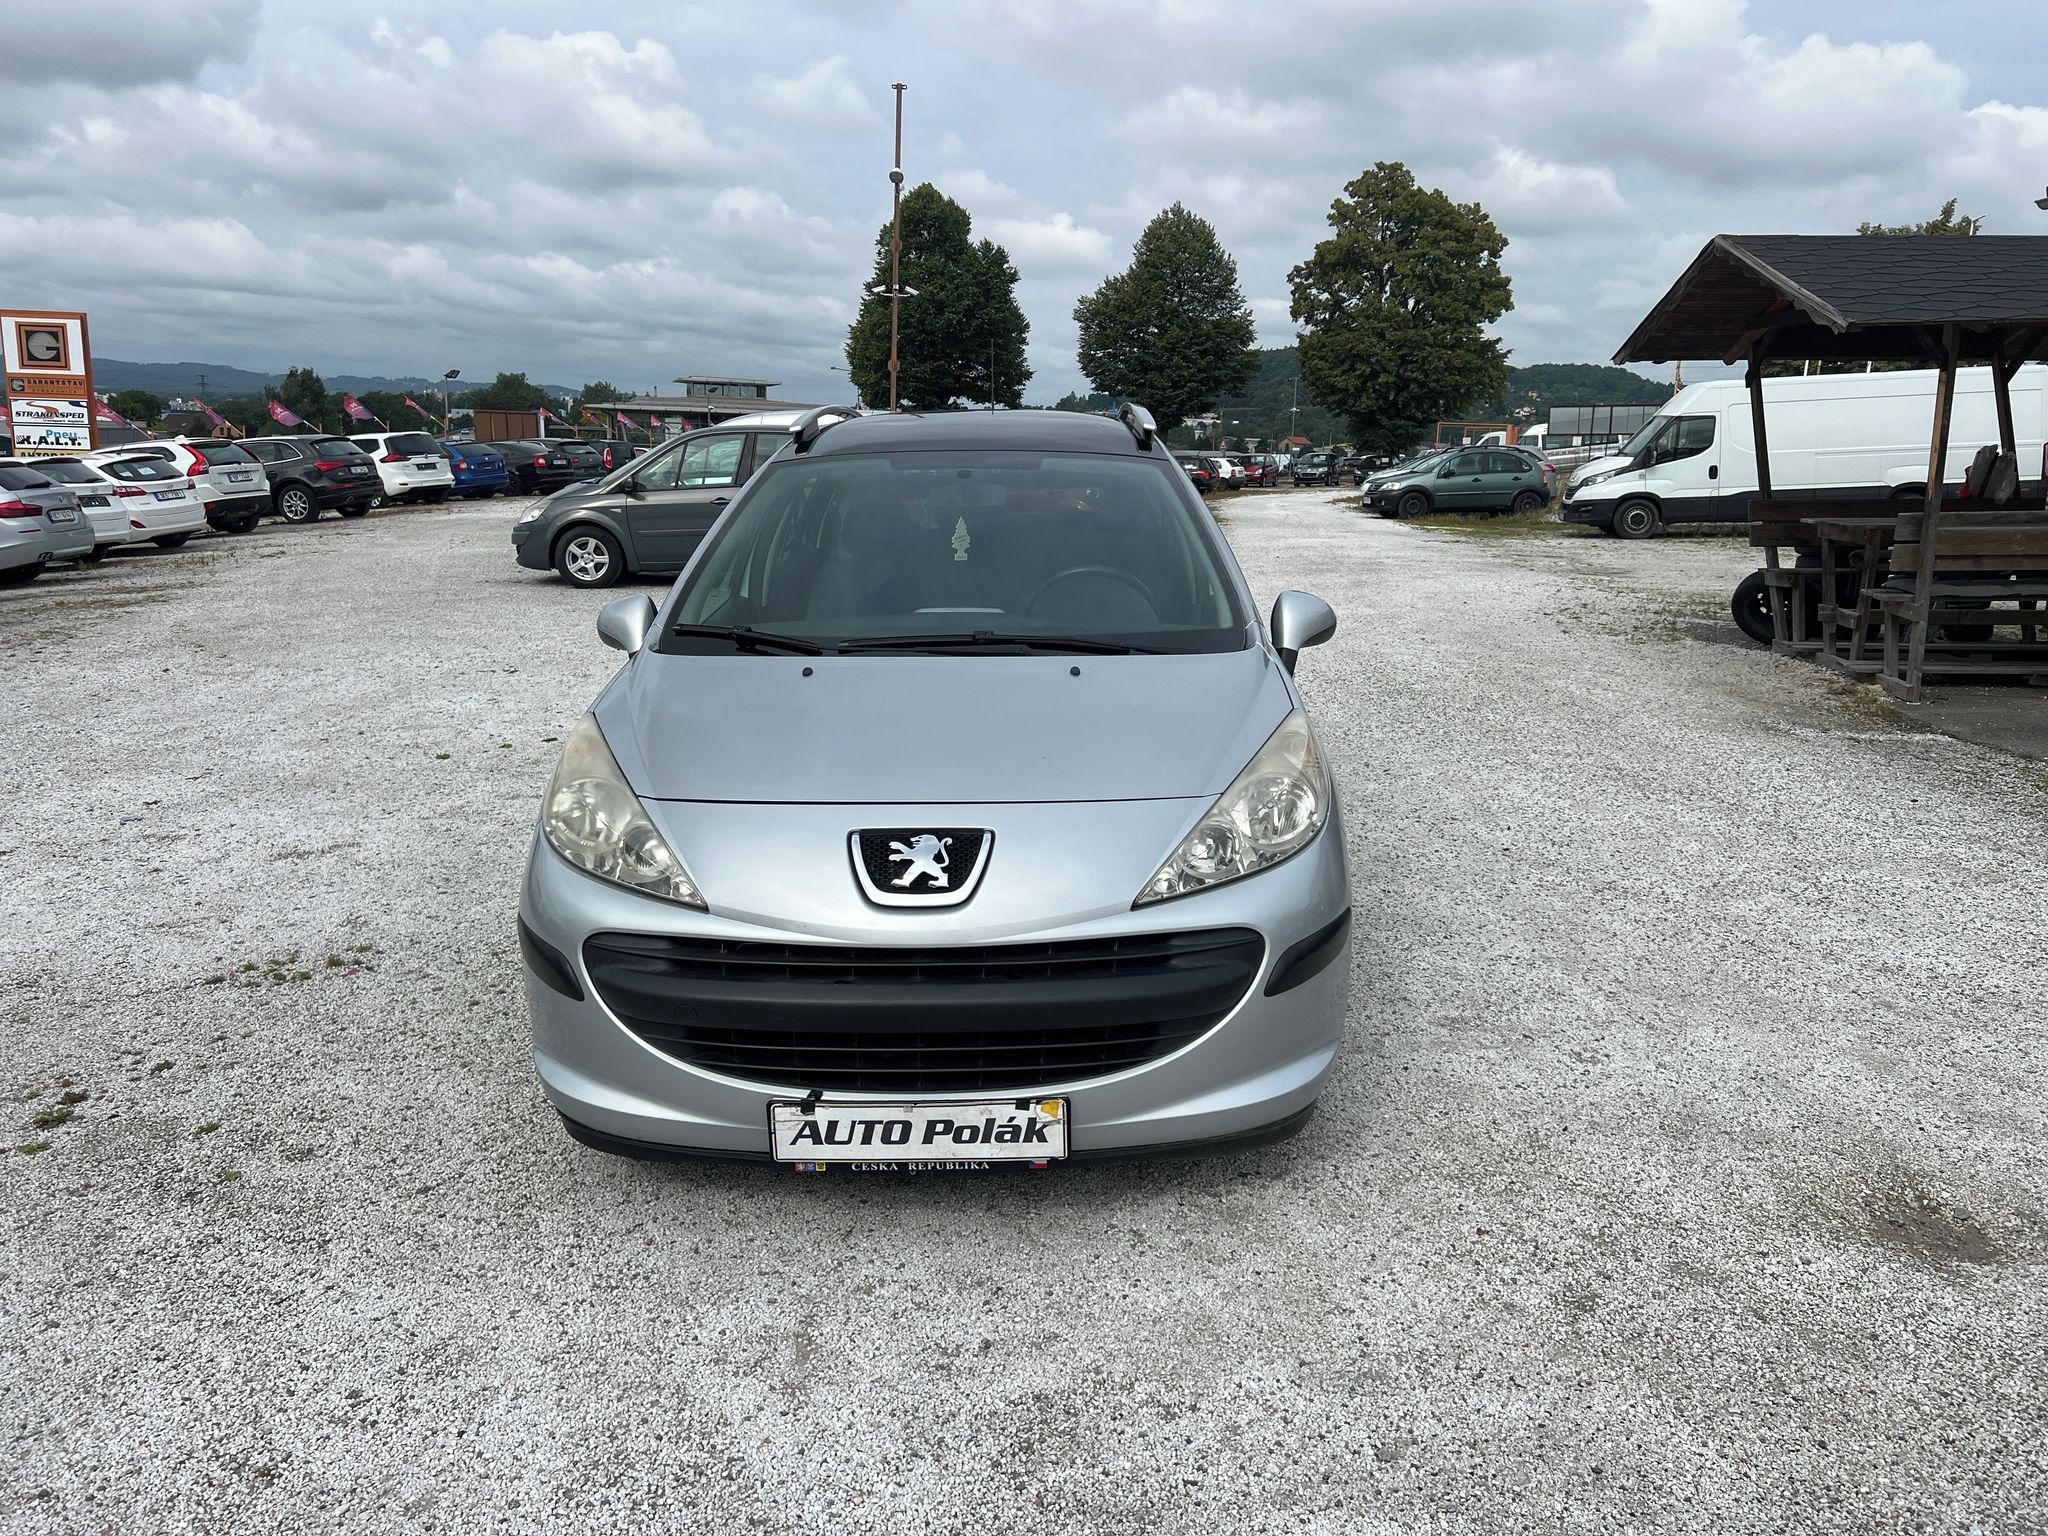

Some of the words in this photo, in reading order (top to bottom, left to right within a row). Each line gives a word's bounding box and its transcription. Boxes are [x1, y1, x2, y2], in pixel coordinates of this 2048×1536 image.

[15, 410, 85, 419] STRAKONSPED
[45, 429, 77, 439] Pneu
[789, 1120, 913, 1146] AUTO
[921, 1116, 1050, 1145] Polák
[908, 1161, 990, 1170] REPUBLIKA
